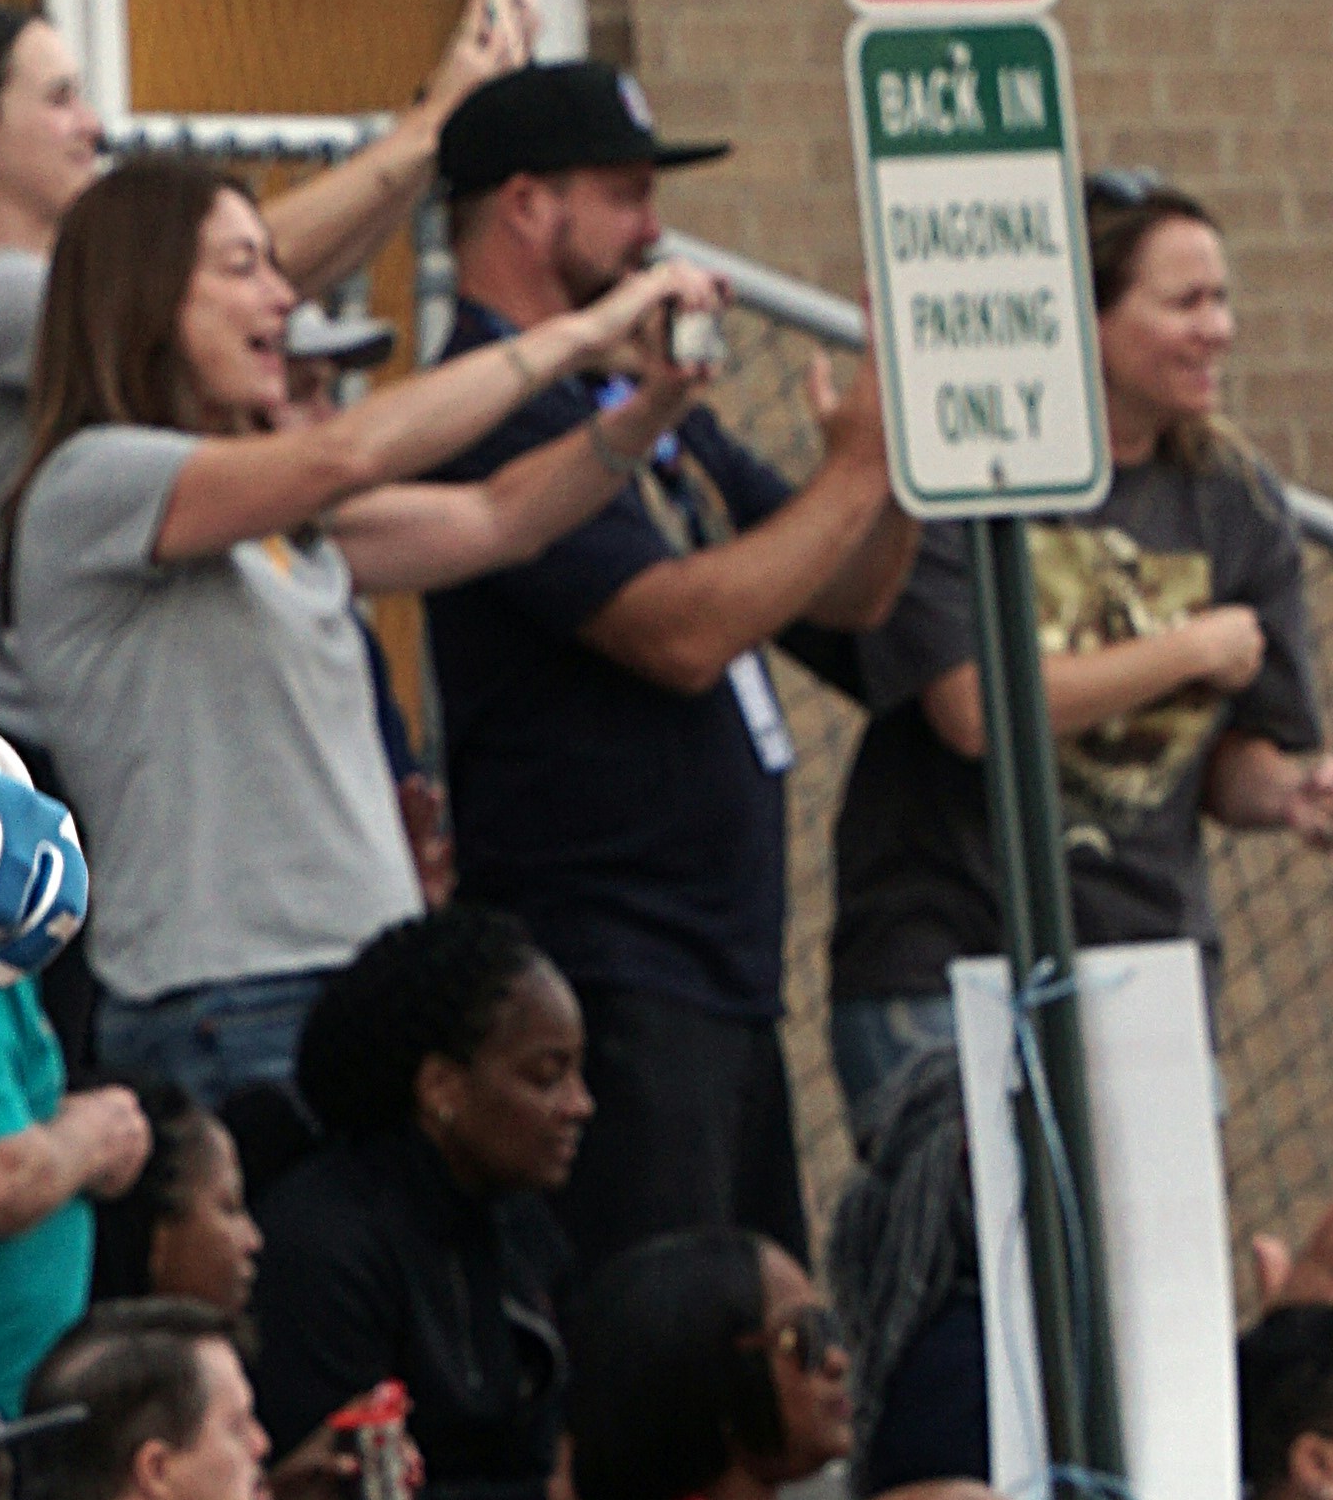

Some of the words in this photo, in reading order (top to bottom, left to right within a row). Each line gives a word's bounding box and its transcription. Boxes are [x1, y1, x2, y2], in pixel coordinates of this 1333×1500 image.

[875, 64, 986, 138] BACK
[996, 65, 1047, 132] IN
[889, 199, 1061, 264] DIAGONAL
[910, 286, 1061, 351] PARKING
[937, 380, 1044, 444] ONLY
